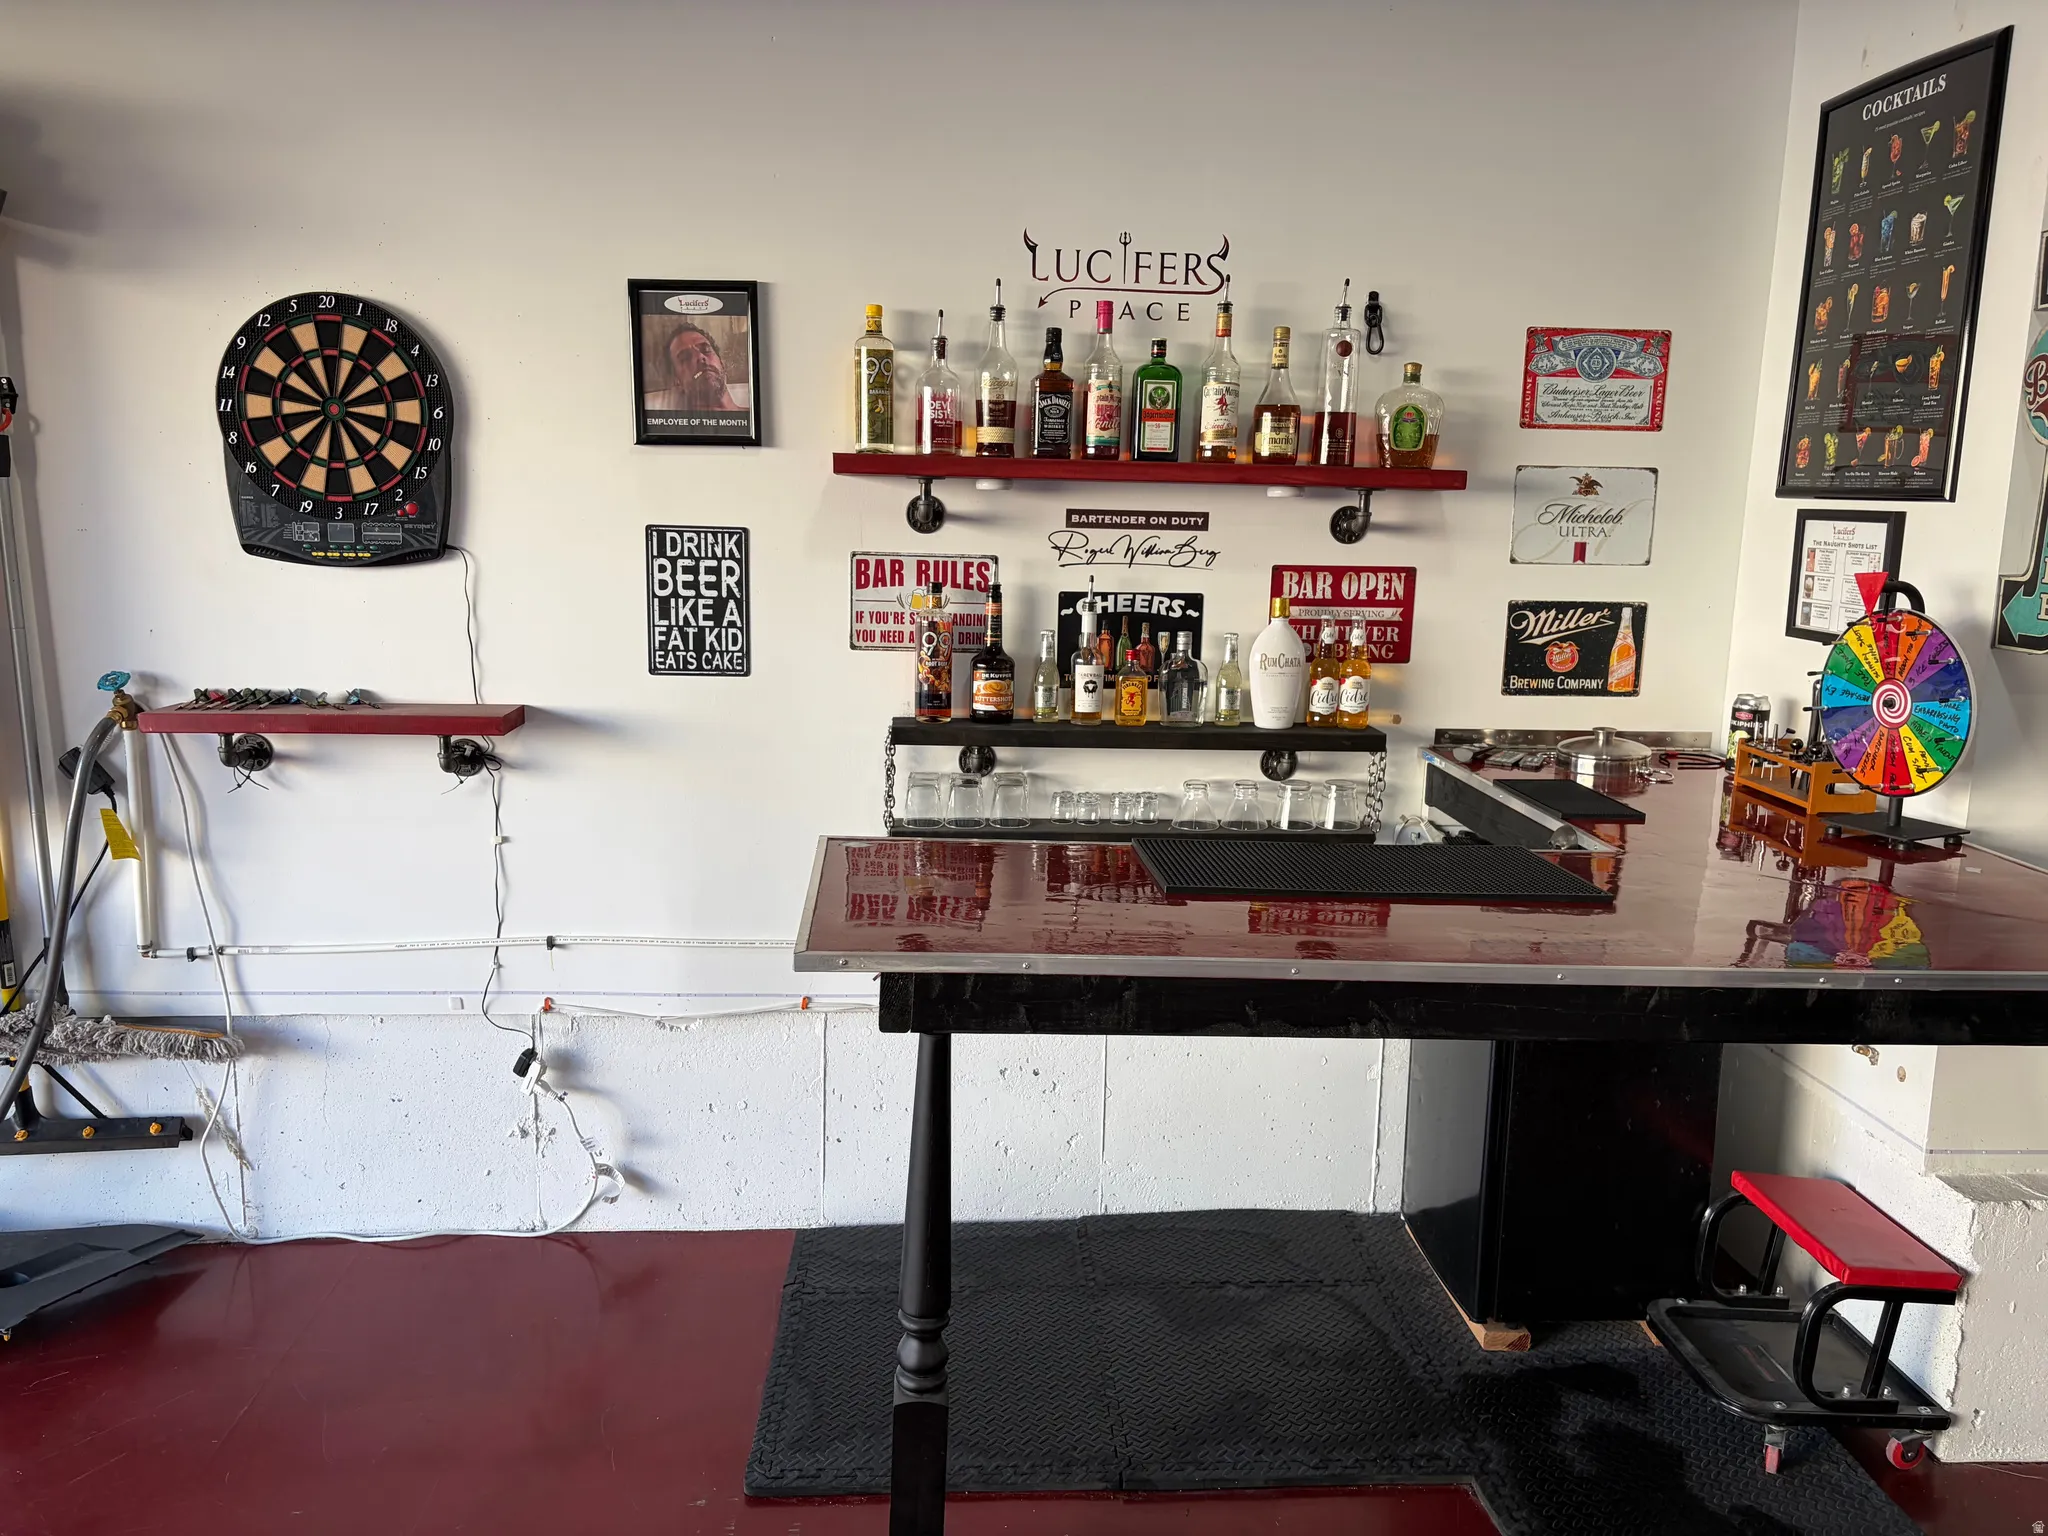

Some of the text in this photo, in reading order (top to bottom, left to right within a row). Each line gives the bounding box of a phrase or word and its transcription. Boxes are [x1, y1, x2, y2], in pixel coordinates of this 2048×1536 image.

[1863, 74, 1946, 120] COCKTAILS
[1023, 227, 1230, 294] LUCIFERS
[289, 300, 297, 312] 5
[319, 296, 335, 308] 20
[356, 304, 363, 316] 1
[1070, 300, 1190, 321] PACE
[257, 314, 271, 327] 12
[384, 318, 398, 333] 18
[237, 336, 246, 349] 9
[411, 345, 420, 357] 4
[222, 367, 235, 378] 14
[866, 357, 893, 384] 99
[425, 374, 438, 387] 13
[1542, 383, 1645, 398] Budweiser Lager Beer
[1039, 398, 1052, 408] JACK
[1524, 376, 1533, 421] GENUINE
[219, 399, 232, 412] 11
[434, 407, 443, 419] 6
[228, 432, 238, 445] 8
[427, 438, 441, 451] 10
[245, 462, 257, 474] 16
[415, 467, 428, 479] 15
[271, 485, 280, 497] 7
[395, 489, 403, 501] 2
[299, 501, 313, 513] 19
[335, 507, 343, 520] 3
[364, 503, 378, 515] 17
[1071, 514, 1204, 526] BARTENDER ON DUTY
[652, 531, 741, 558] I DRINK
[653, 558, 741, 598] BEER
[856, 559, 990, 593] BAR RULES
[1283, 571, 1406, 600] BAR OPEN
[654, 598, 742, 627] LIKE A
[856, 611, 864, 624] IF
[869, 611, 905, 624] YOU'RE
[1298, 608, 1385, 618] PROUDLY SERVING
[1510, 608, 1612, 642] Miller
[654, 627, 742, 651] FAT KID
[856, 630, 878, 643] YOU
[880, 631, 904, 643] NEED
[958, 632, 985, 646] DRIN
[922, 632, 952, 656] 99
[656, 651, 742, 670] EATS CAKE
[1898, 655, 1909, 677] MOON
[1835, 649, 1872, 686] POLE DANCE
[1510, 675, 1604, 689] BREWING COMPANY
[1340, 689, 1368, 705] Cidre
[1825, 684, 1870, 702] MESSAGE EX
[1939, 721, 1959, 733] PHOTO
[1903, 736, 1927, 783] CUM SHT
